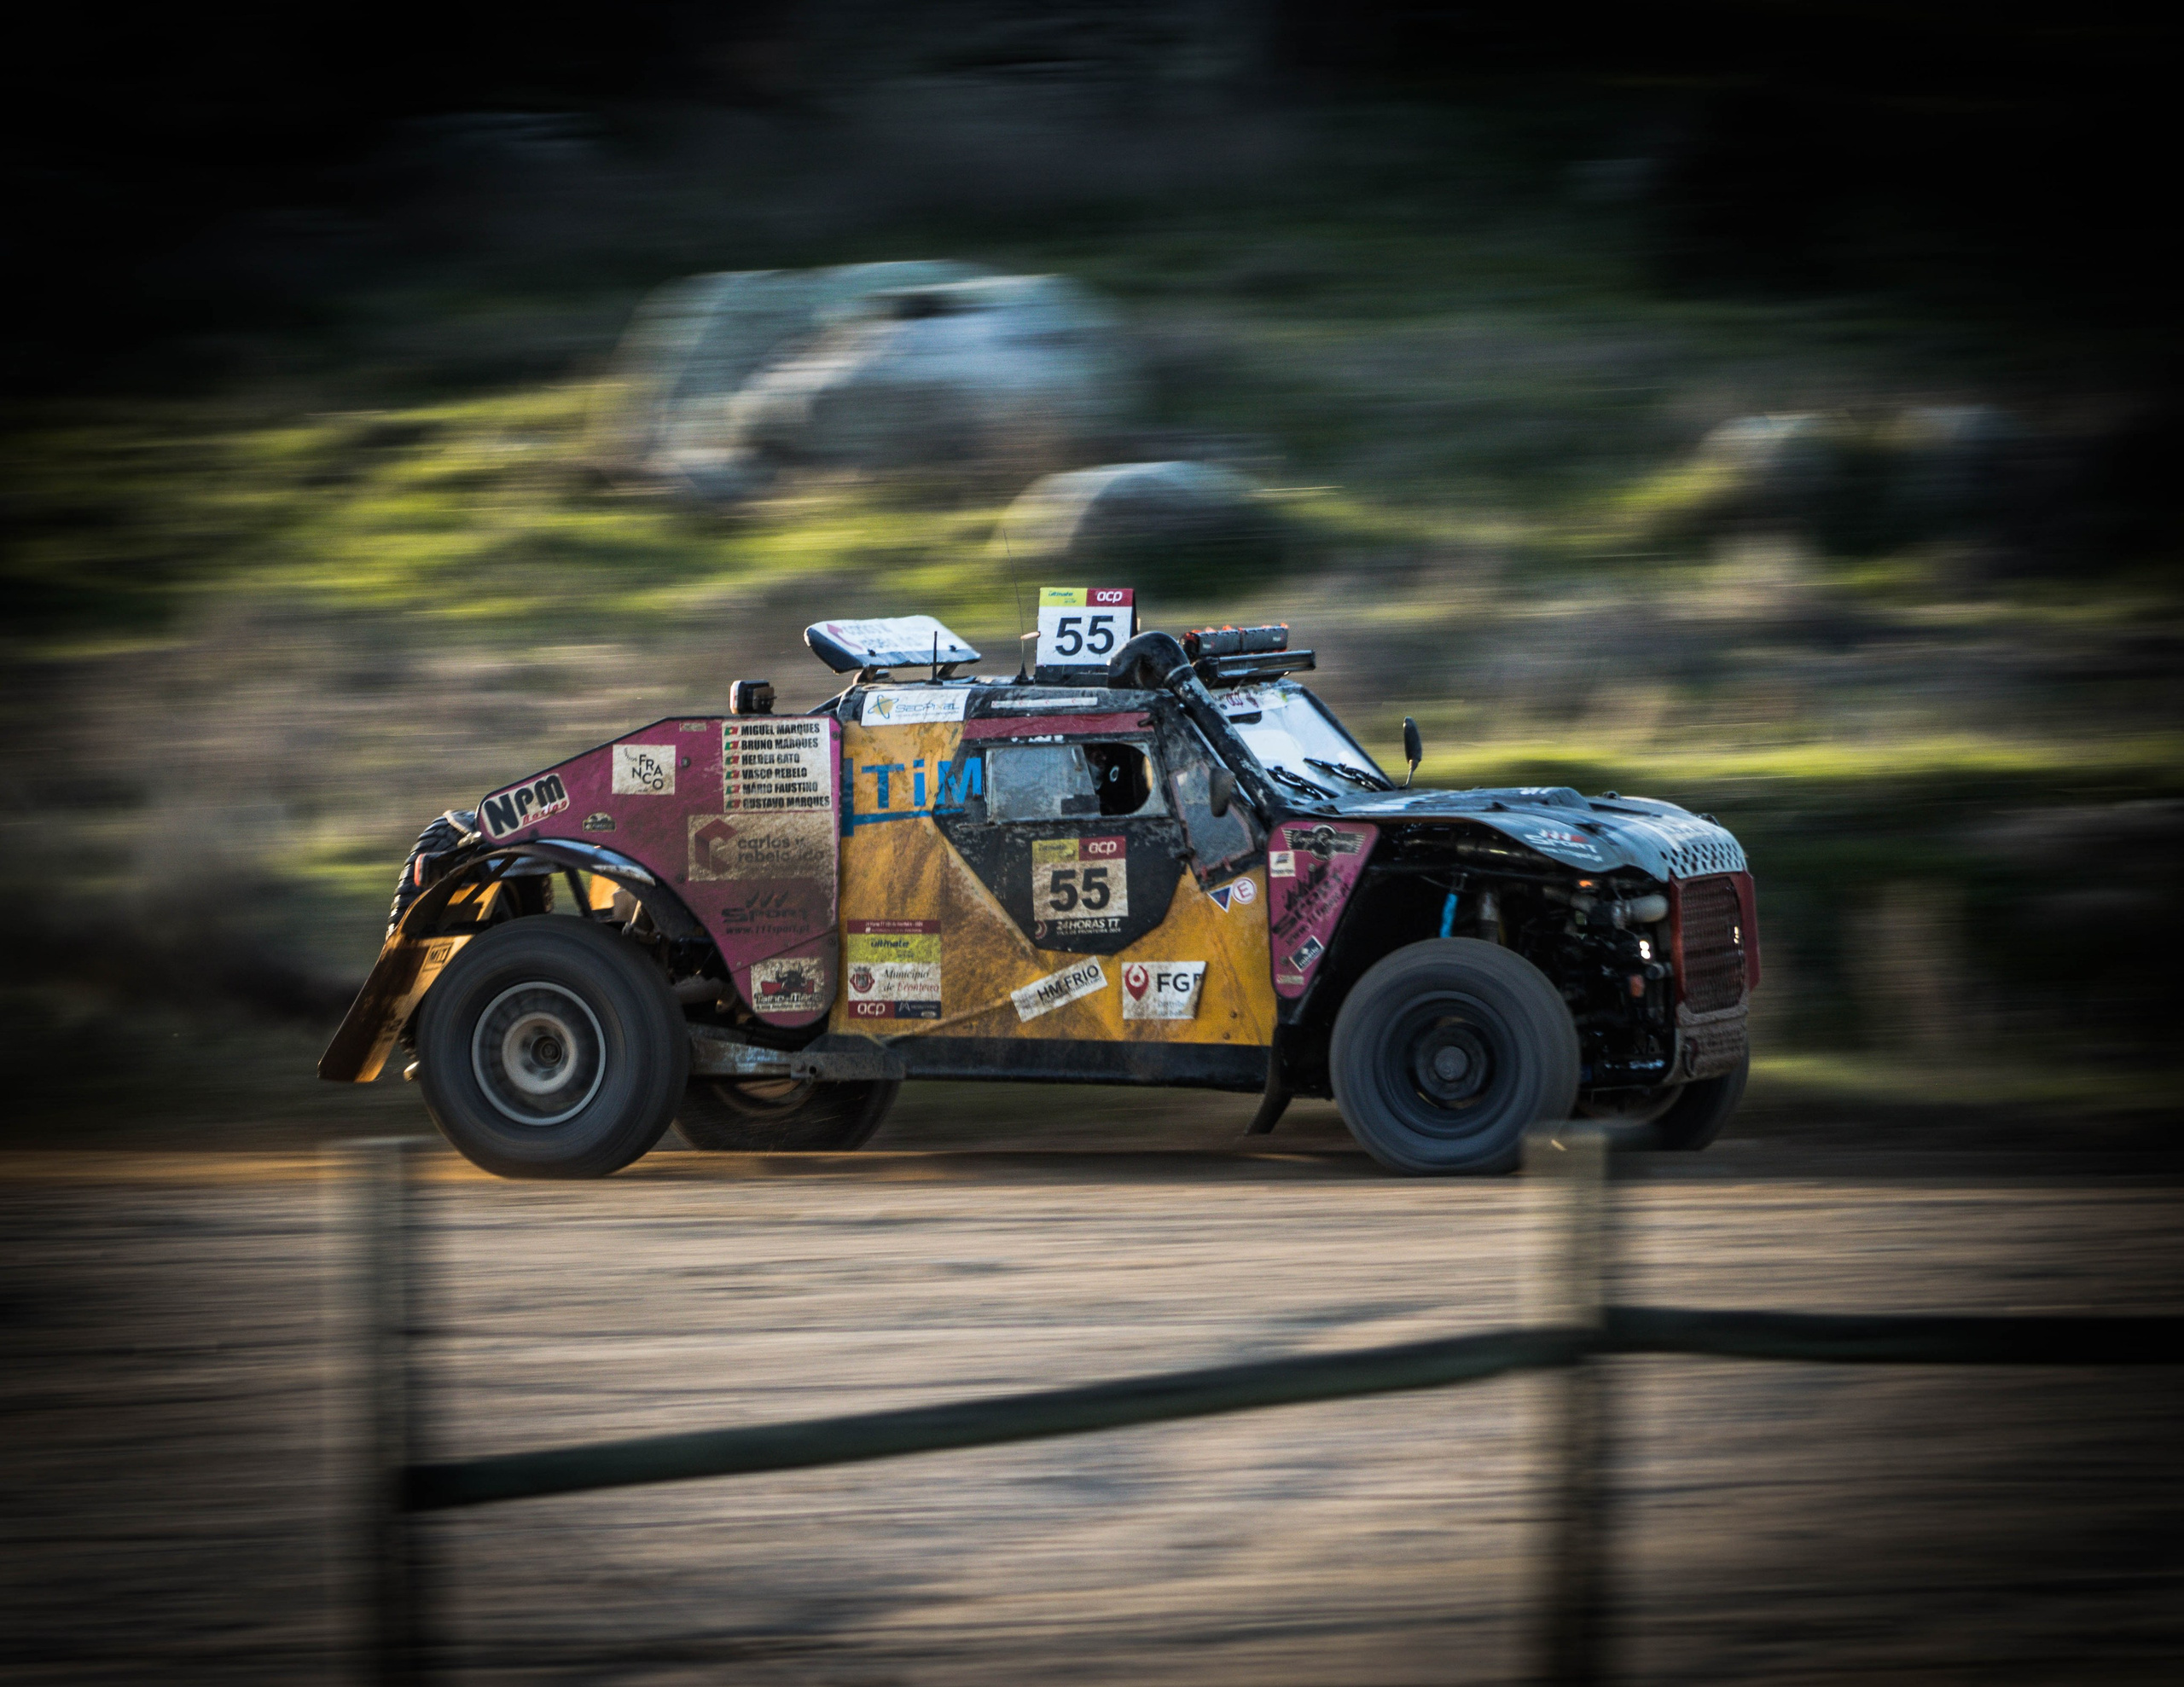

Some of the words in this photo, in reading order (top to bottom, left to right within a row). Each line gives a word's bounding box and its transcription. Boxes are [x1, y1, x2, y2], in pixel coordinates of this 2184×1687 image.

[1096, 591, 1123, 604] acp
[1054, 615, 1114, 657] 55
[741, 724, 775, 736] MIGUEL
[776, 723, 820, 735] MARQUES
[741, 739, 773, 751] BRUNO
[775, 738, 819, 750] MARQUES
[741, 754, 775, 765] HELDER
[742, 768, 773, 780] VASCO
[775, 768, 808, 780] REBELO
[775, 781, 818, 793] FAUSTINO
[742, 797, 785, 809] GUSTAVO
[786, 796, 830, 809] MARQUES
[737, 834, 791, 849] carlos
[1088, 840, 1118, 855] acp
[1049, 867, 1111, 913] 55
[1107, 918, 1121, 928] TT
[1037, 982, 1064, 1000] HM
[1066, 965, 1100, 989] FRIO
[857, 1002, 886, 1016] acp
